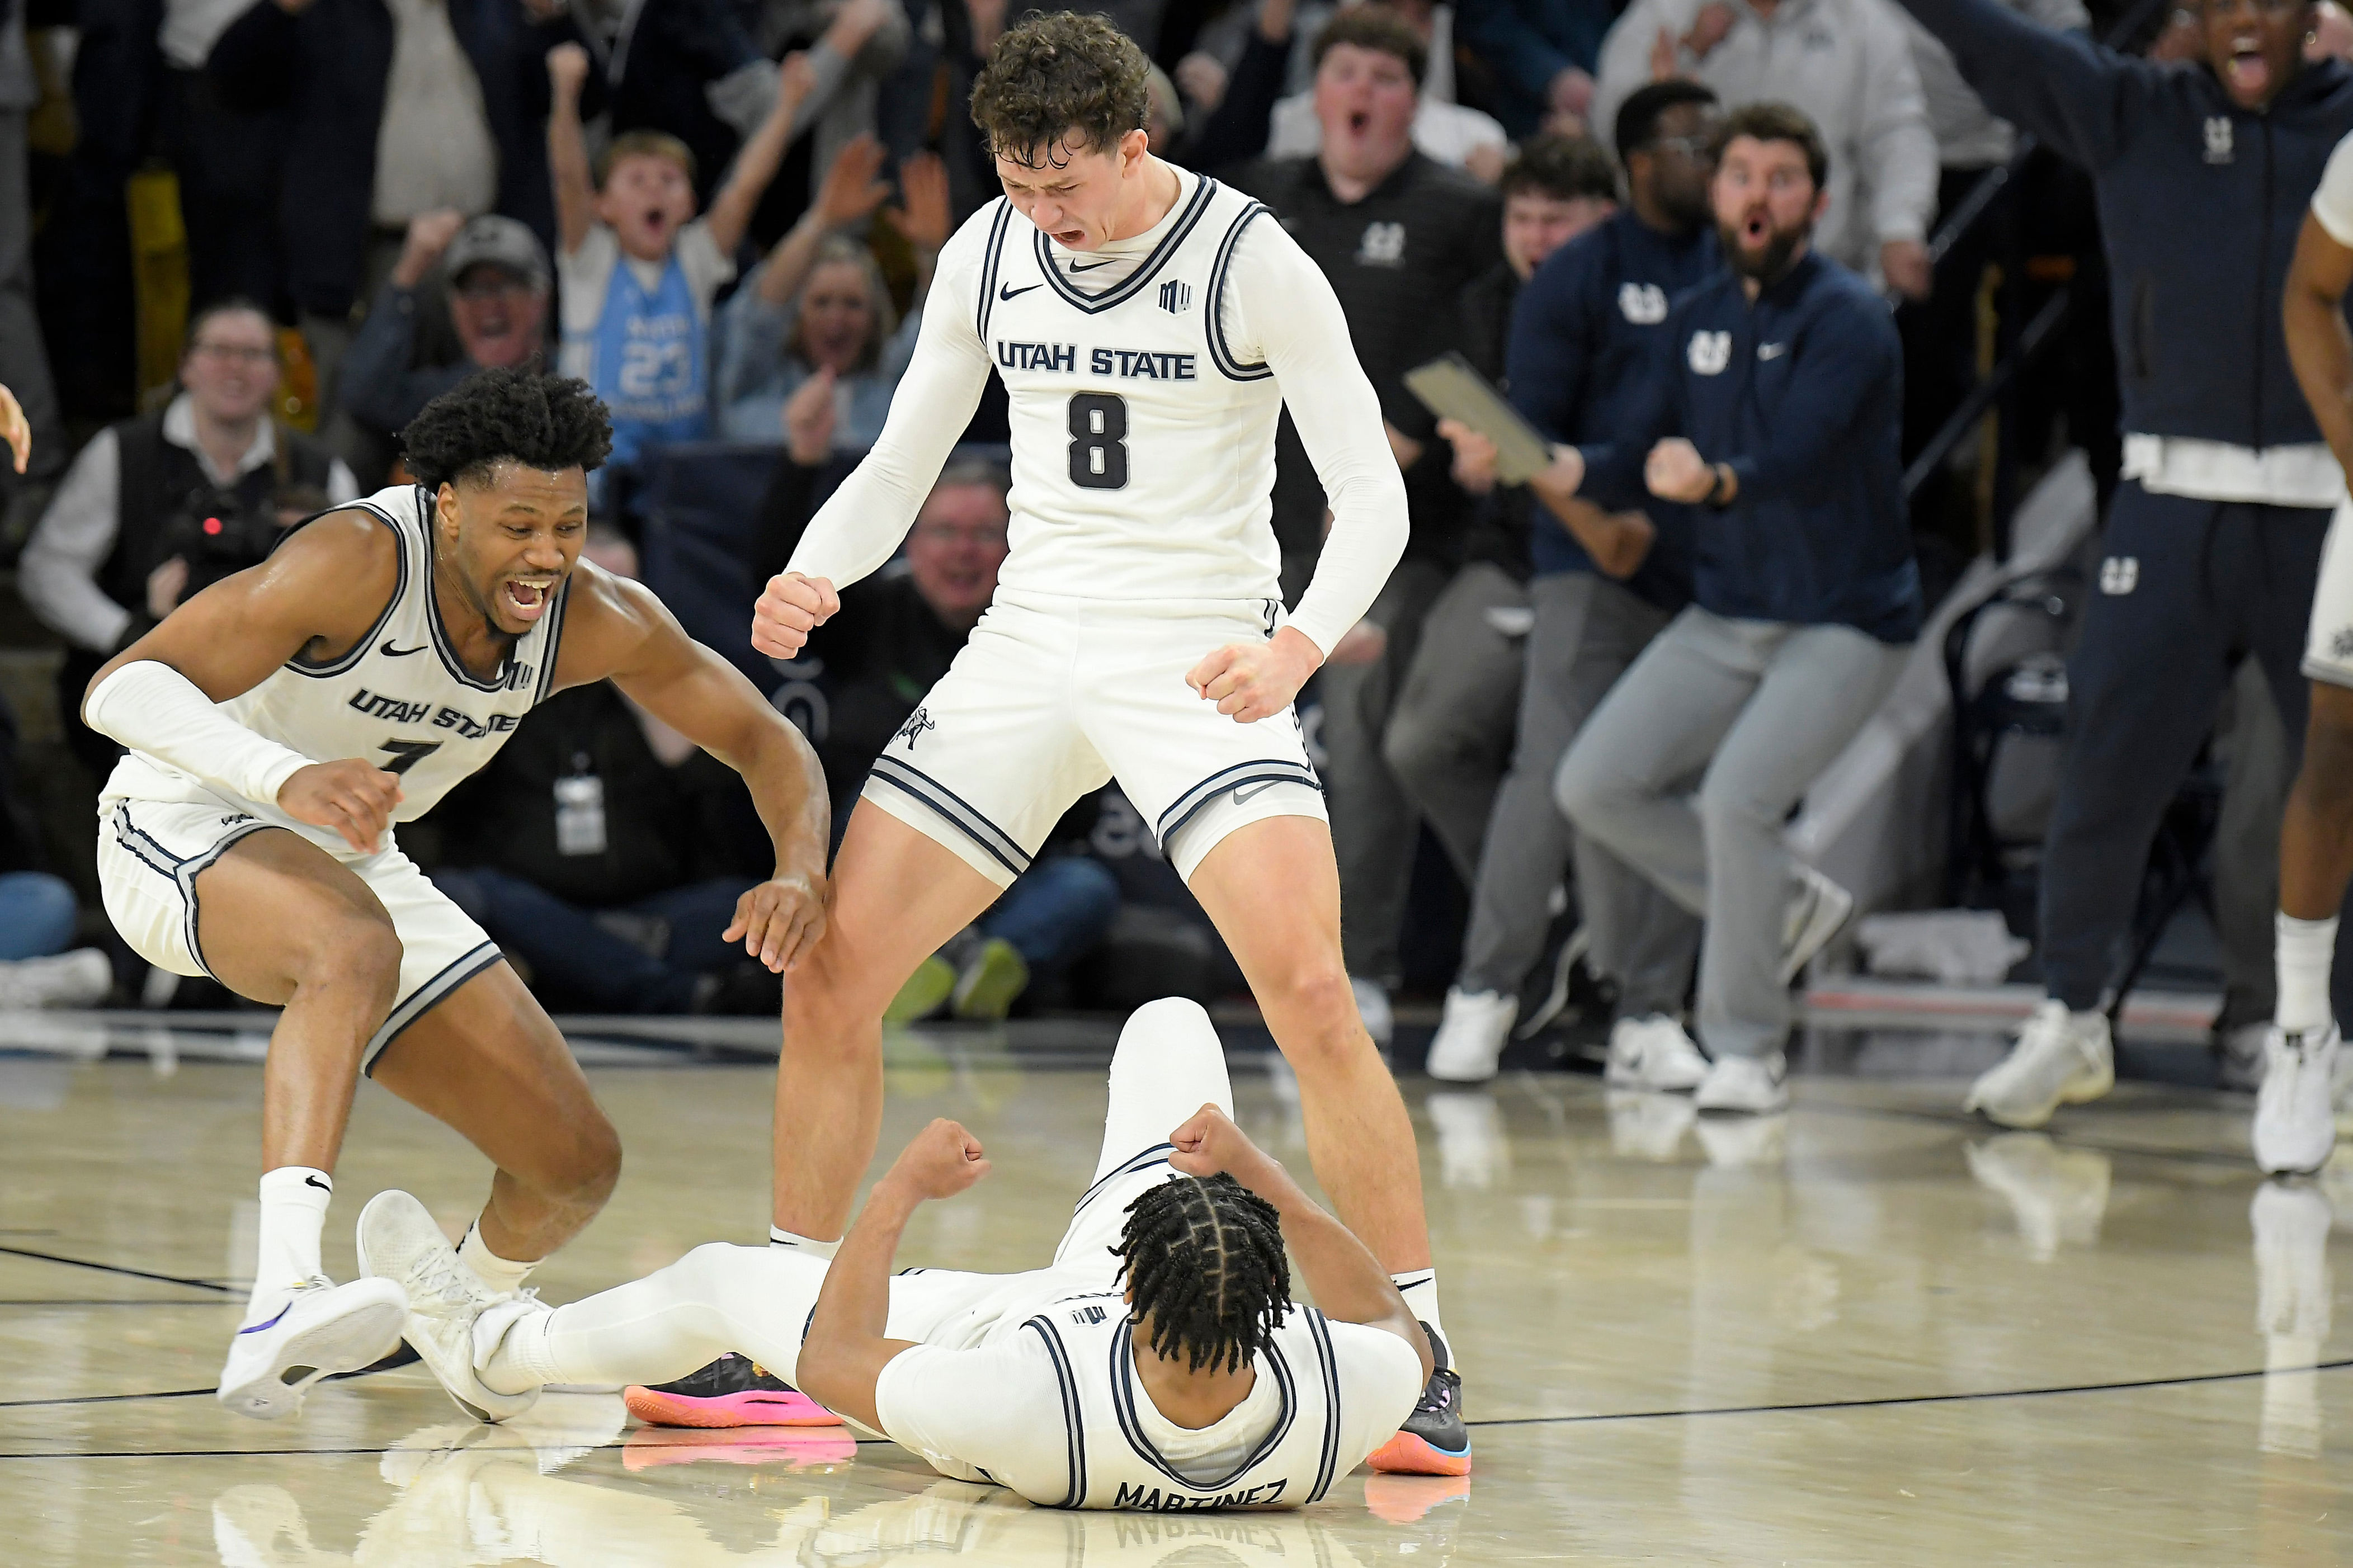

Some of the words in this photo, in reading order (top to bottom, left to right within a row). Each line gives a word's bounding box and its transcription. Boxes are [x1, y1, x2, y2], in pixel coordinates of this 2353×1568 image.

[997, 340, 1077, 374] UTAH
[1091, 347, 1198, 382] STATE
[1066, 390, 1131, 491] 8
[348, 688, 432, 724] UTAH
[377, 737, 445, 776] 7
[1113, 1477, 1288, 1510] MARTINEZ
